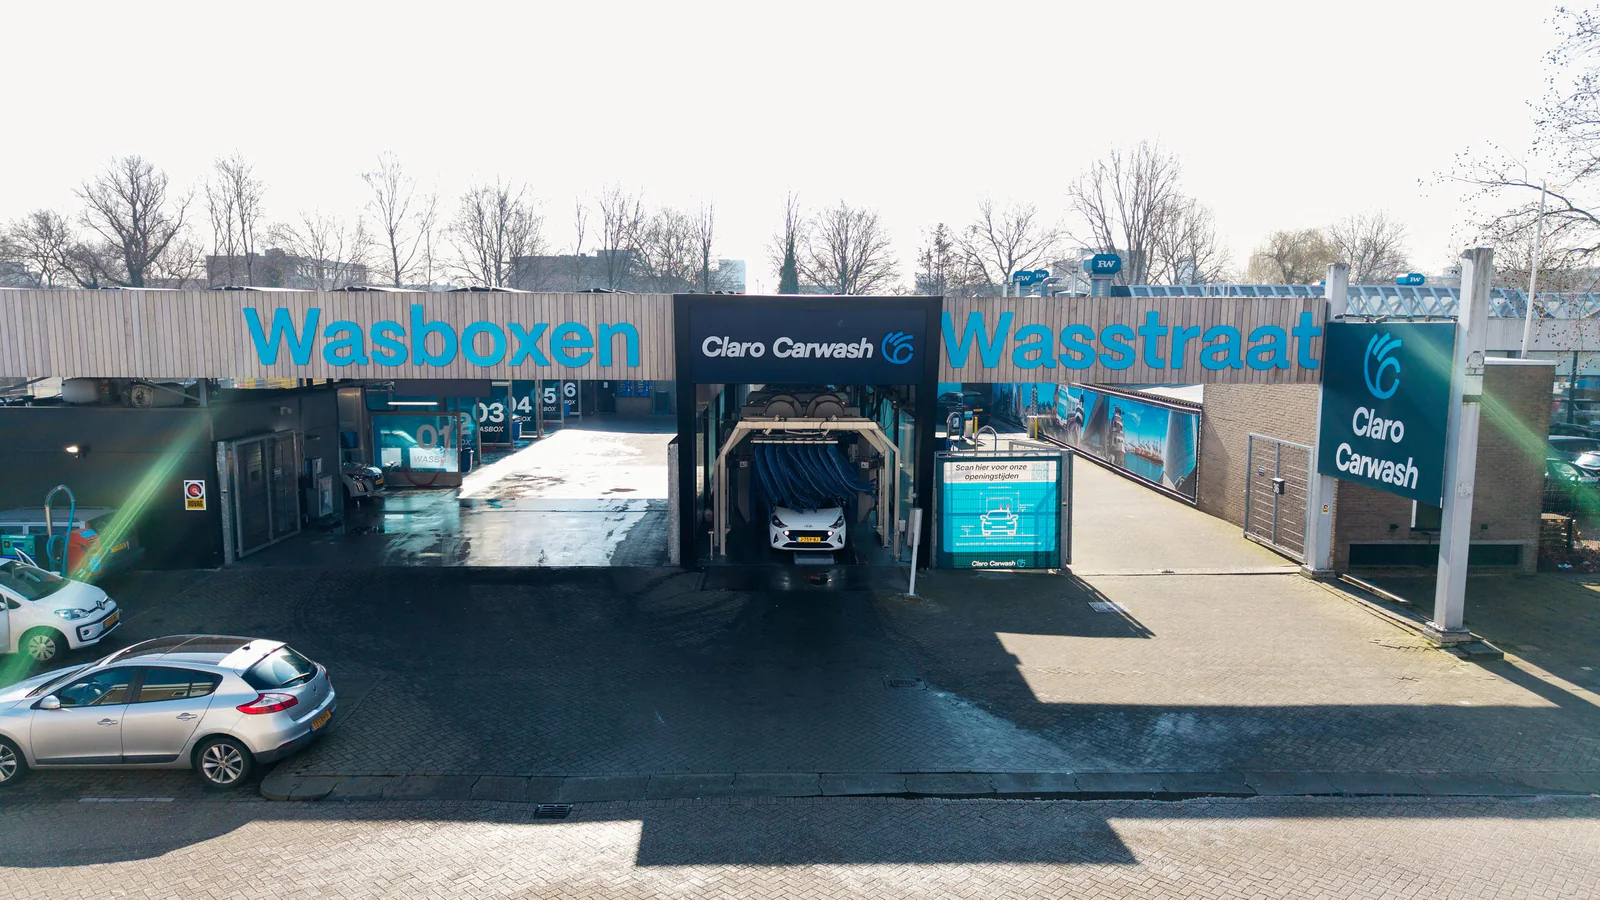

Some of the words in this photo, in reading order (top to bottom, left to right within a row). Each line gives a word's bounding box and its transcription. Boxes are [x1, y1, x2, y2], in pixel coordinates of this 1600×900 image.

[242, 304, 639, 368] Wasboxen
[701, 335, 766, 358] Claro
[772, 336, 874, 359] Carwash
[941, 310, 1322, 371] Wasstraat
[472, 402, 504, 423] 03
[1352, 406, 1405, 444] Claro
[416, 424, 451, 451] 01
[480, 425, 504, 433] ASBOX
[955, 464, 974, 472] Scan
[975, 463, 990, 471] hier
[1009, 463, 1028, 471] onze
[964, 473, 1019, 481] openingstijden
[1335, 442, 1419, 490] Carwash
